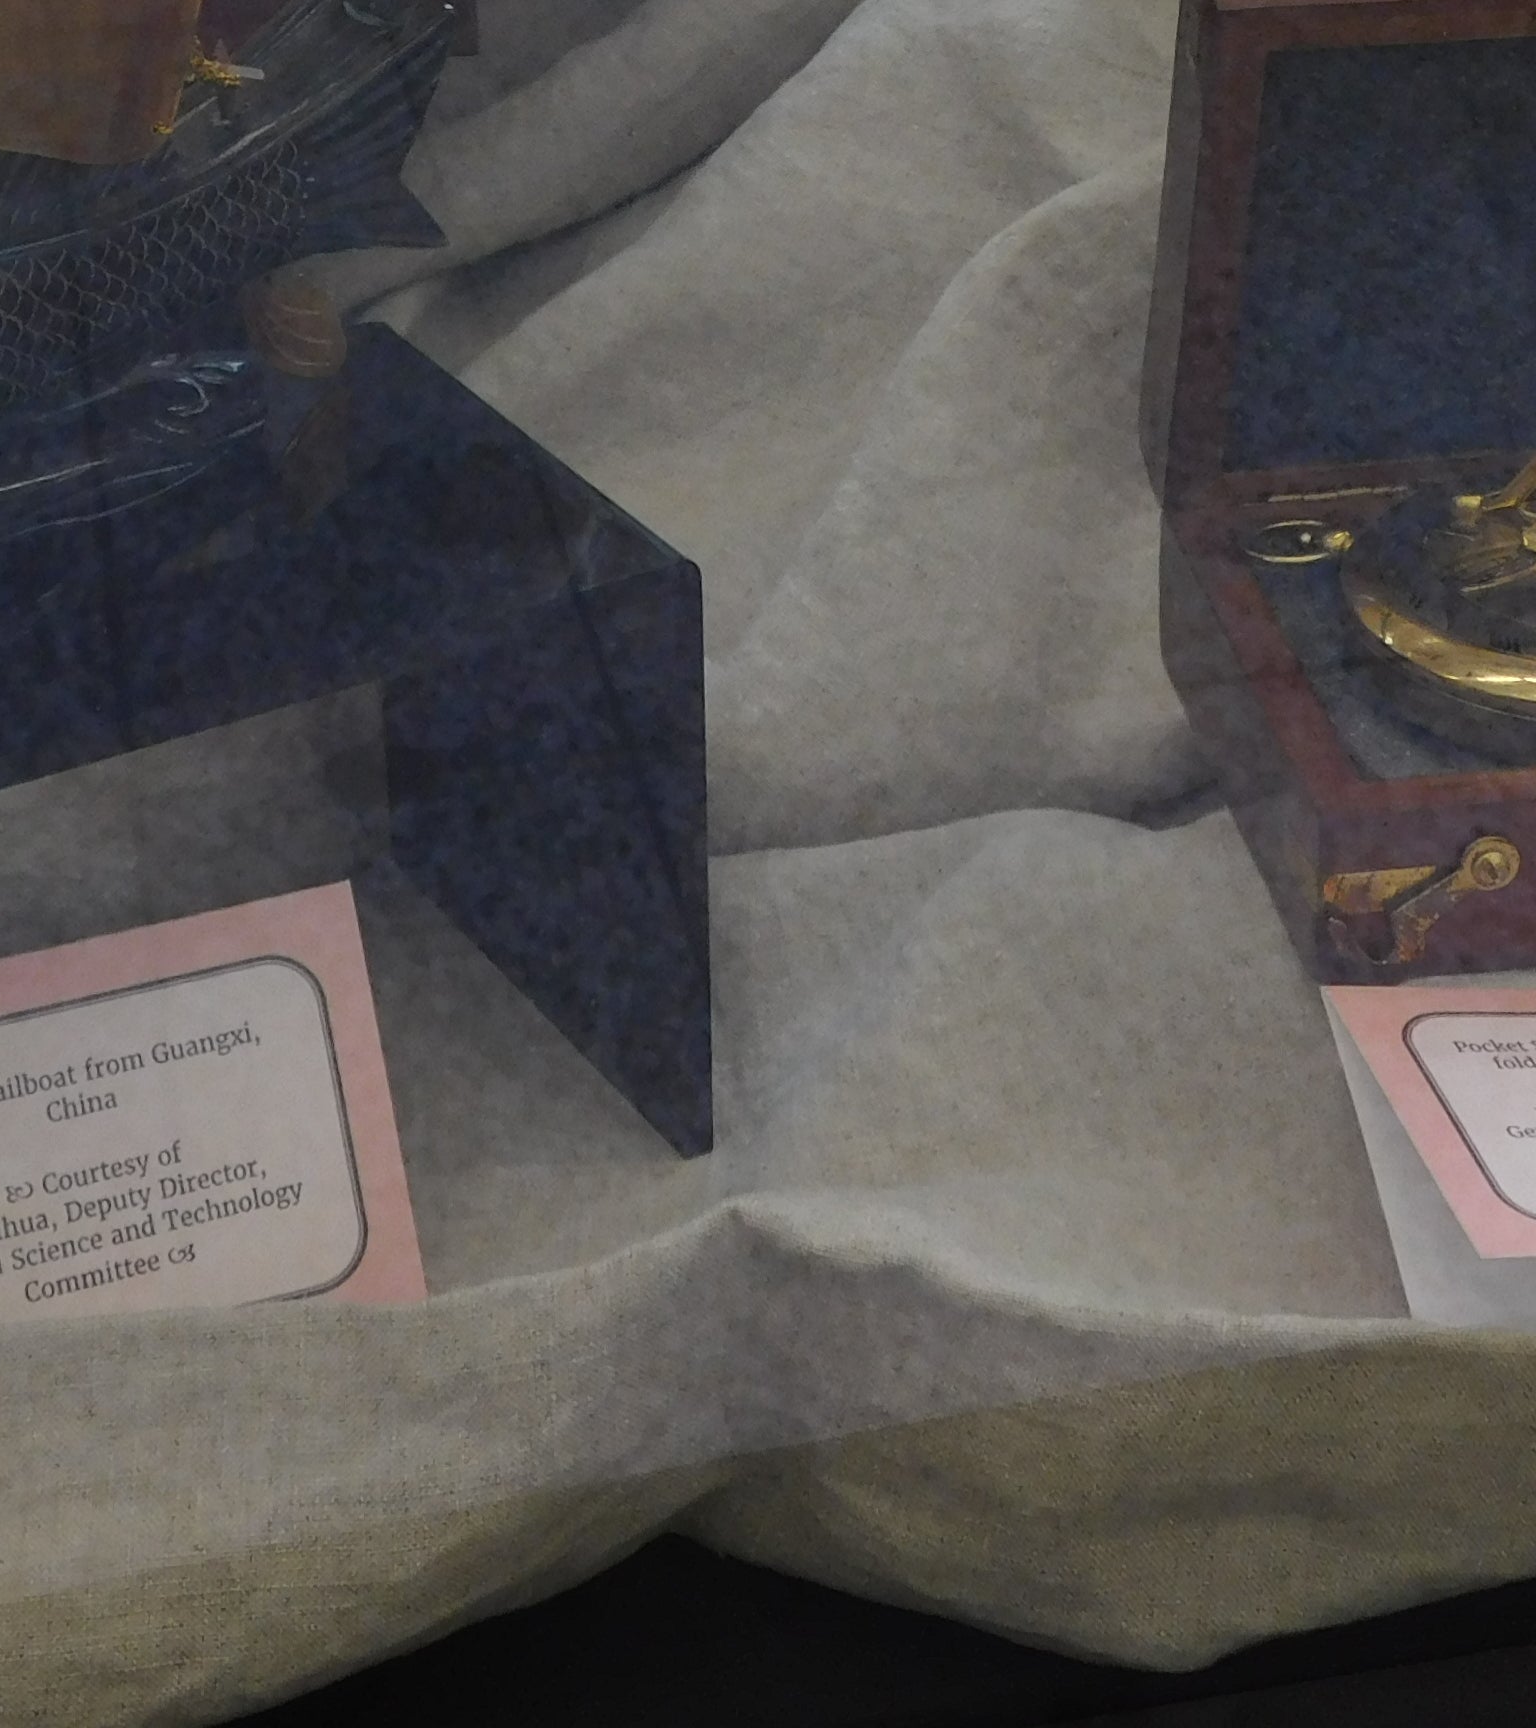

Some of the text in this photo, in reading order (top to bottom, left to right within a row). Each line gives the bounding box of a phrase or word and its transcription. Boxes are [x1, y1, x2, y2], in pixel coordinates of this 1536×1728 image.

[83, 1047, 146, 1082] from
[151, 1020, 263, 1065] Guangxi,
[1452, 1040, 1529, 1053] Pocket
[45, 1088, 119, 1124] China
[41, 1139, 184, 1197] Courtesy of
[64, 1184, 153, 1228] Deputy
[158, 1158, 267, 1201] Director,
[11, 1233, 103, 1271] Science
[110, 1217, 158, 1248] and
[161, 1178, 304, 1233] Technology
[23, 1252, 162, 1304] Committee
